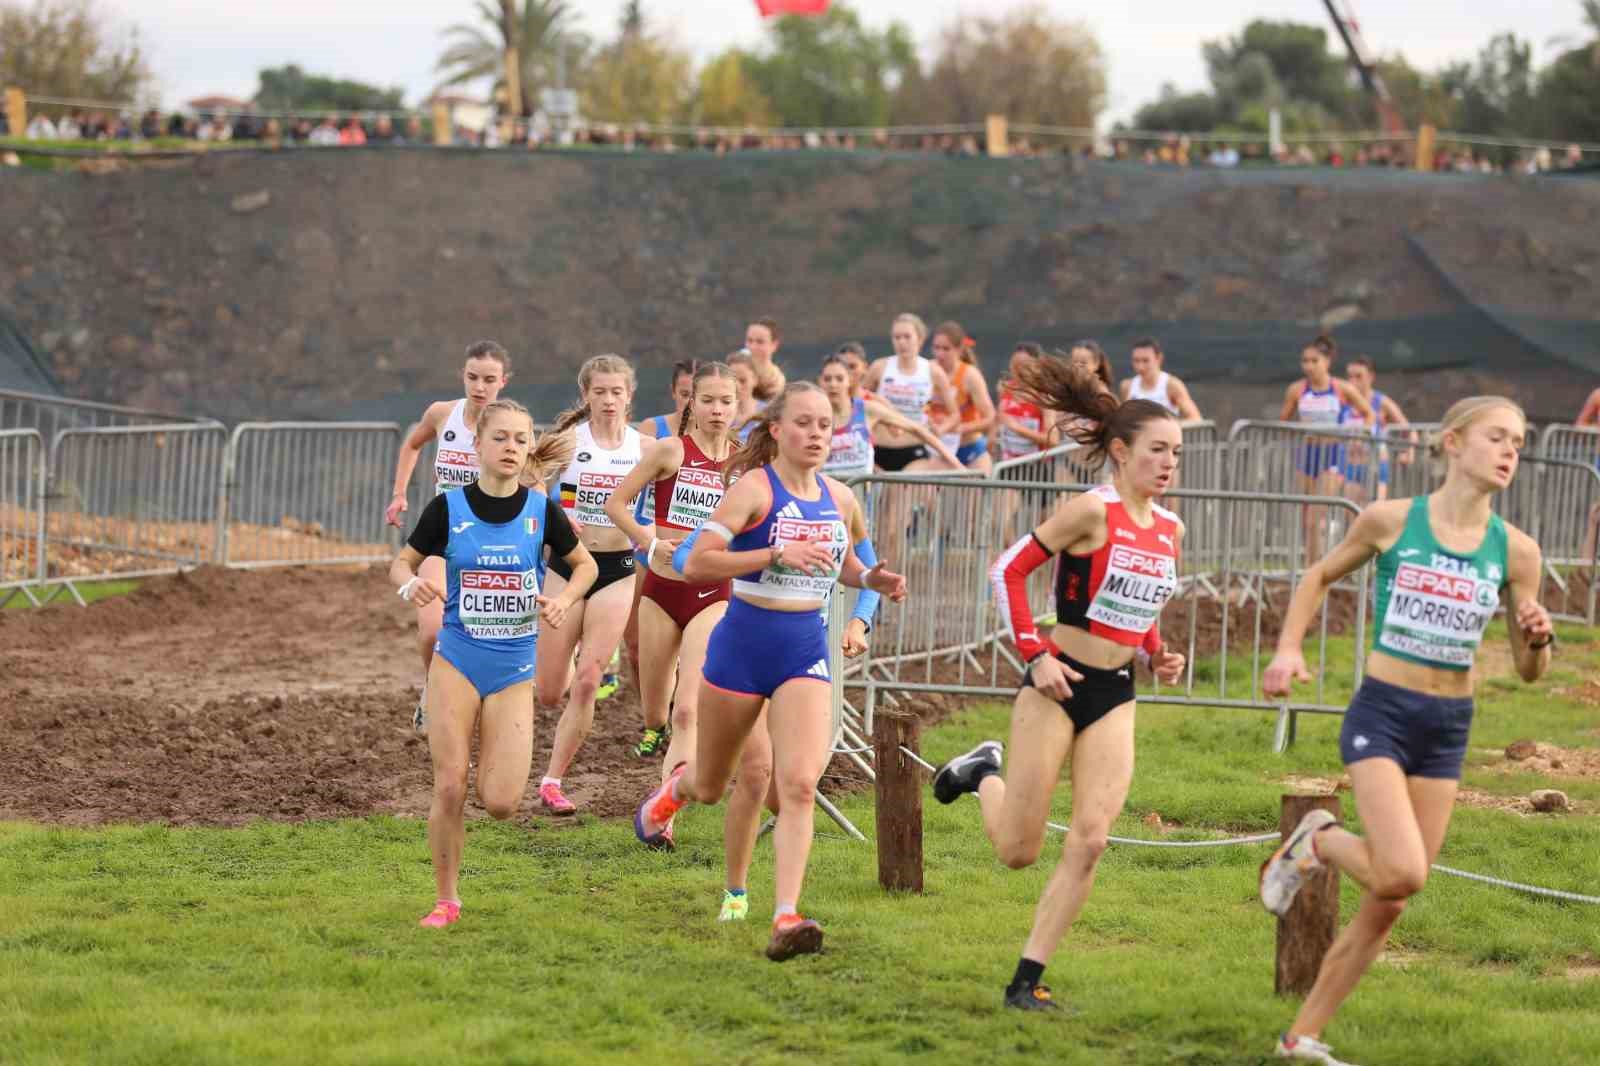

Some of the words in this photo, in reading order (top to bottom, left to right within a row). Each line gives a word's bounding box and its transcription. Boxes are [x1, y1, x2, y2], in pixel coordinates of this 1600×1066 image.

[780, 523, 832, 542] SPAR
[476, 555, 520, 566] ITALIA
[1111, 550, 1166, 578] SPAR
[463, 574, 521, 589] SPAR
[766, 575, 811, 588] ANTALYA
[1397, 567, 1473, 602] SPAR
[1392, 593, 1485, 632] MORRISON
